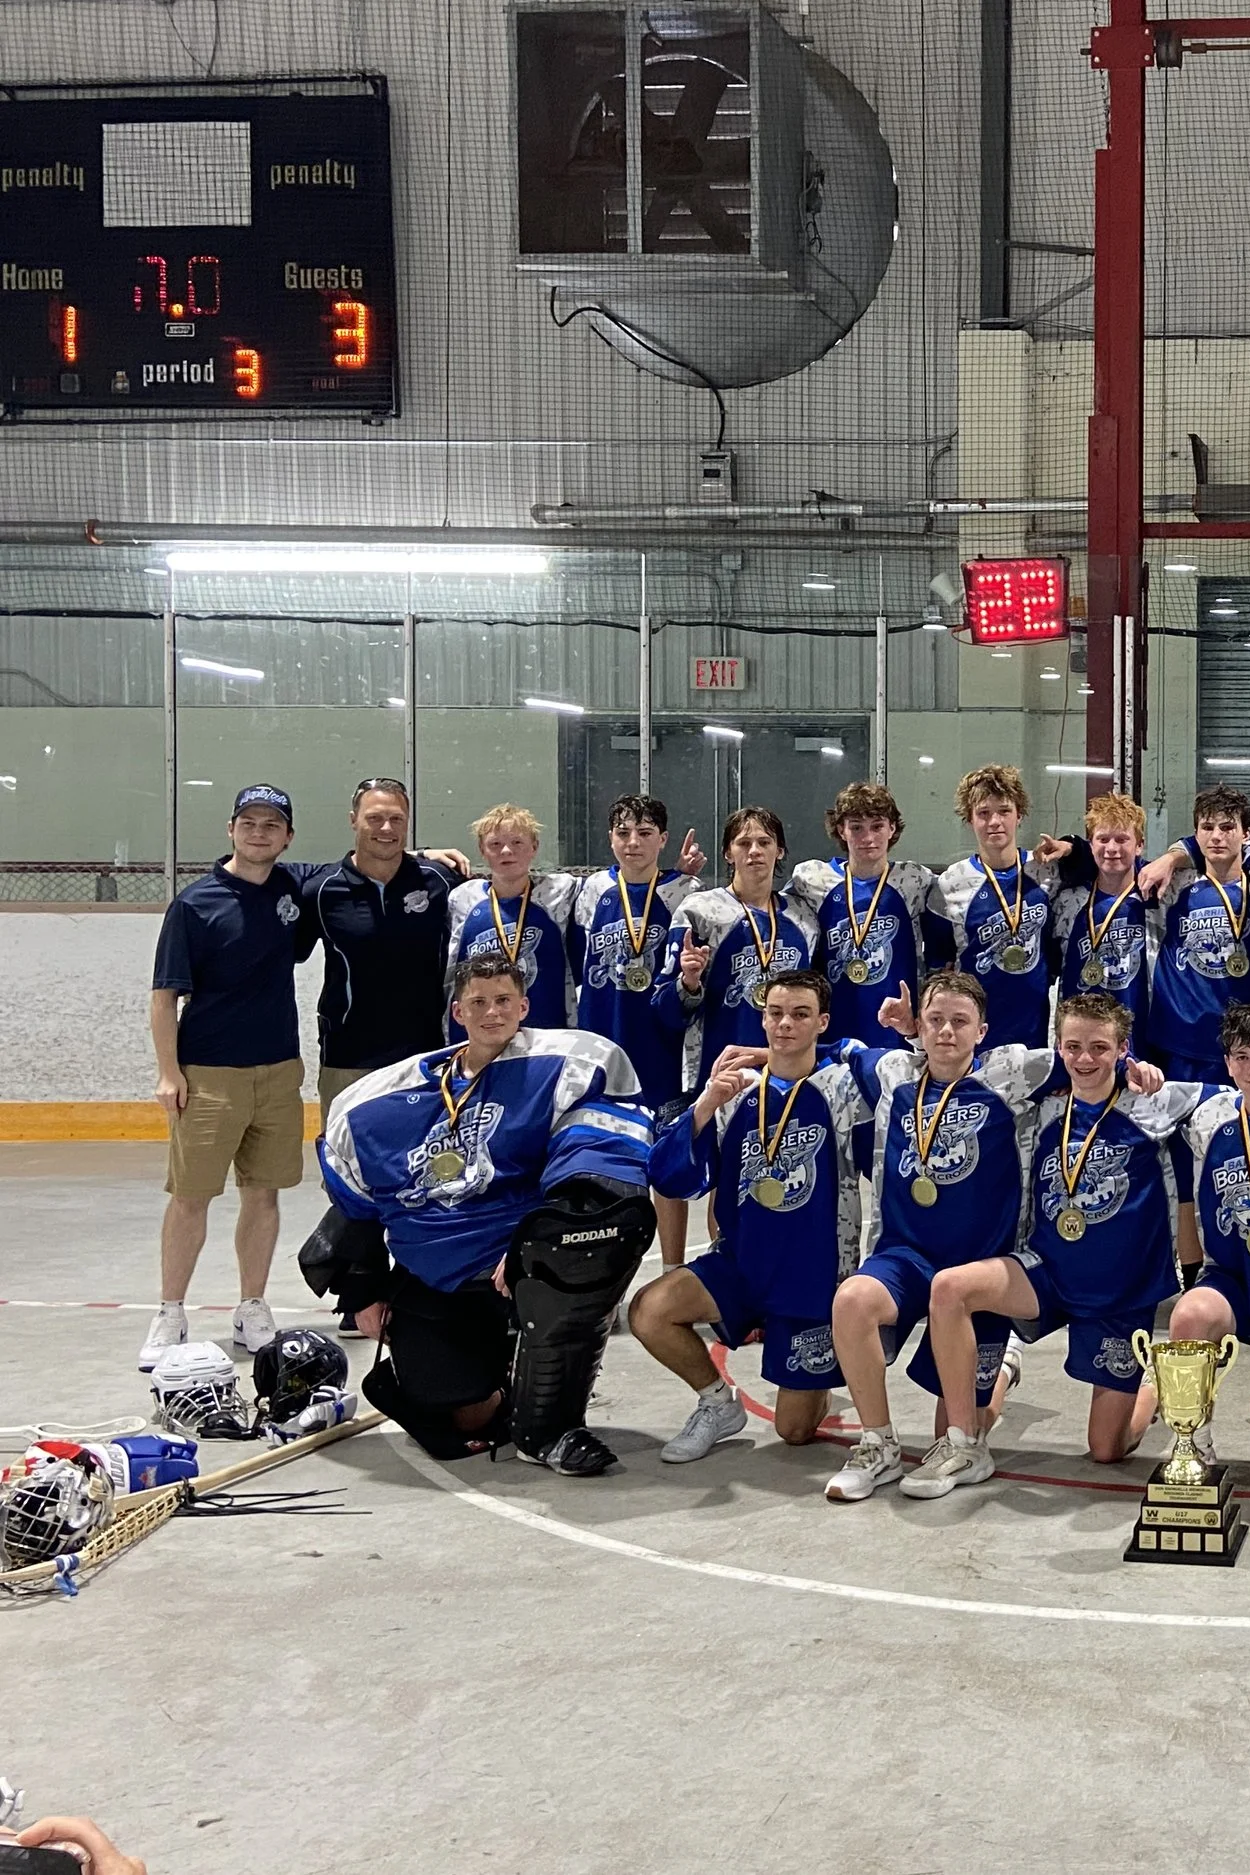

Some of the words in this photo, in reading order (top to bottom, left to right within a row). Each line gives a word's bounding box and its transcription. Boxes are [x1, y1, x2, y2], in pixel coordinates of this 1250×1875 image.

[2, 161, 84, 192] penalty
[270, 158, 355, 190] penalty
[2, 263, 63, 290] Home
[284, 262, 363, 290] Guests
[64, 304, 77, 362] 1
[334, 302, 367, 365] 3
[142, 357, 215, 387] period
[235, 348, 261, 395] 3
[977, 569, 1057, 634] 22
[696, 660, 738, 687] EXIT
[1181, 917, 1231, 933] BOMBE
[470, 929, 535, 956] BOMES
[904, 1106, 980, 1134] BMBERS
[741, 1128, 818, 1160] BOBERS
[561, 1227, 619, 1245] BODDAM
[1161, 1516, 1202, 1525] CHAMPIONS
